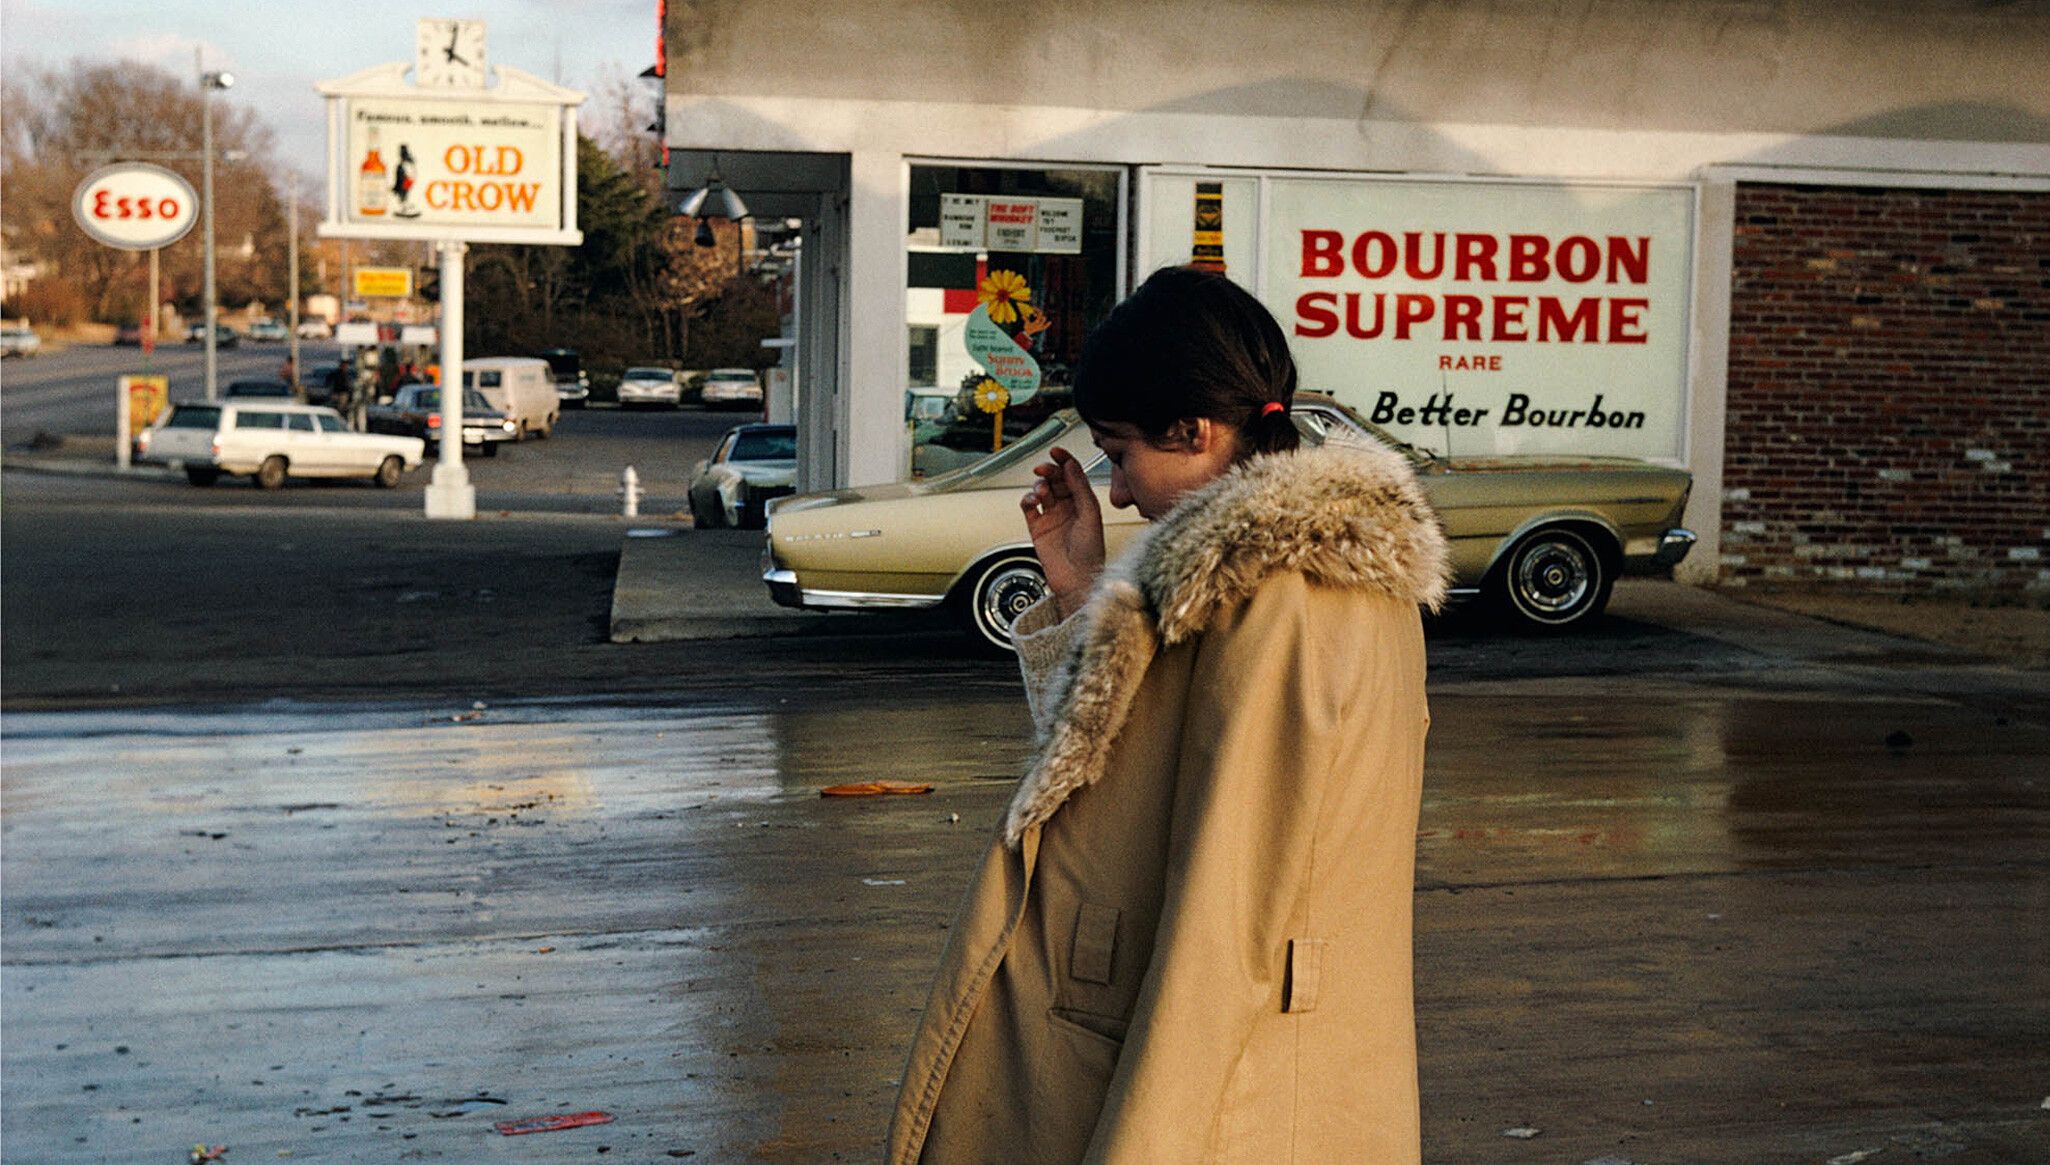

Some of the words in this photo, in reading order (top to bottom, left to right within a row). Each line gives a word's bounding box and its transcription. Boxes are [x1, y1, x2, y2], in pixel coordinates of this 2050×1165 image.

[444, 145, 524, 176] OLD
[93, 189, 179, 220] Esso
[425, 180, 541, 213] CROW
[1300, 229, 1650, 284] BOURBON
[1295, 291, 1649, 344] SUPREME
[1439, 355, 1503, 371] RARE
[1371, 391, 1488, 427] Better
[1500, 393, 1645, 428] Bourbon
